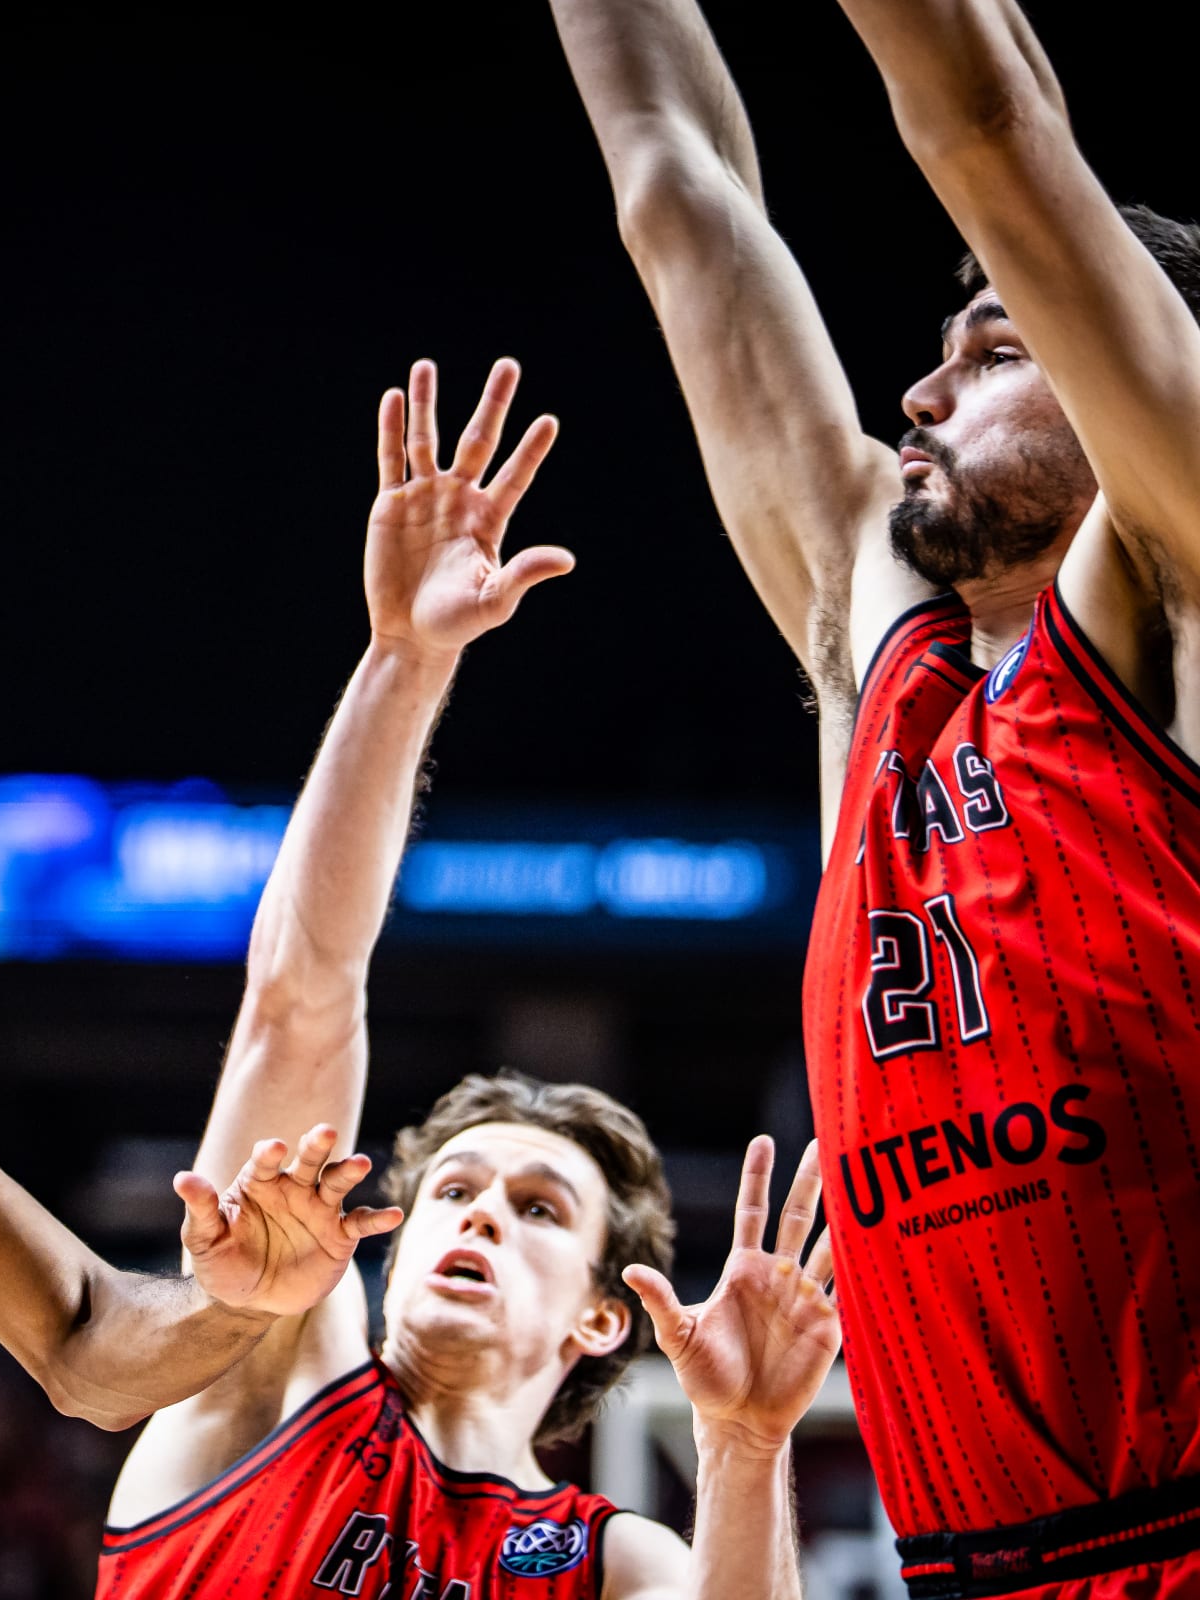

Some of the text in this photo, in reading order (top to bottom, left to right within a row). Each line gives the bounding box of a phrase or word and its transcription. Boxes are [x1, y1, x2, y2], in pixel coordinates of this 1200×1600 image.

[862, 894, 991, 1062] 21
[840, 1083, 1107, 1229] UTENOS
[898, 1178, 1052, 1239] NEALKOHOLINIS
